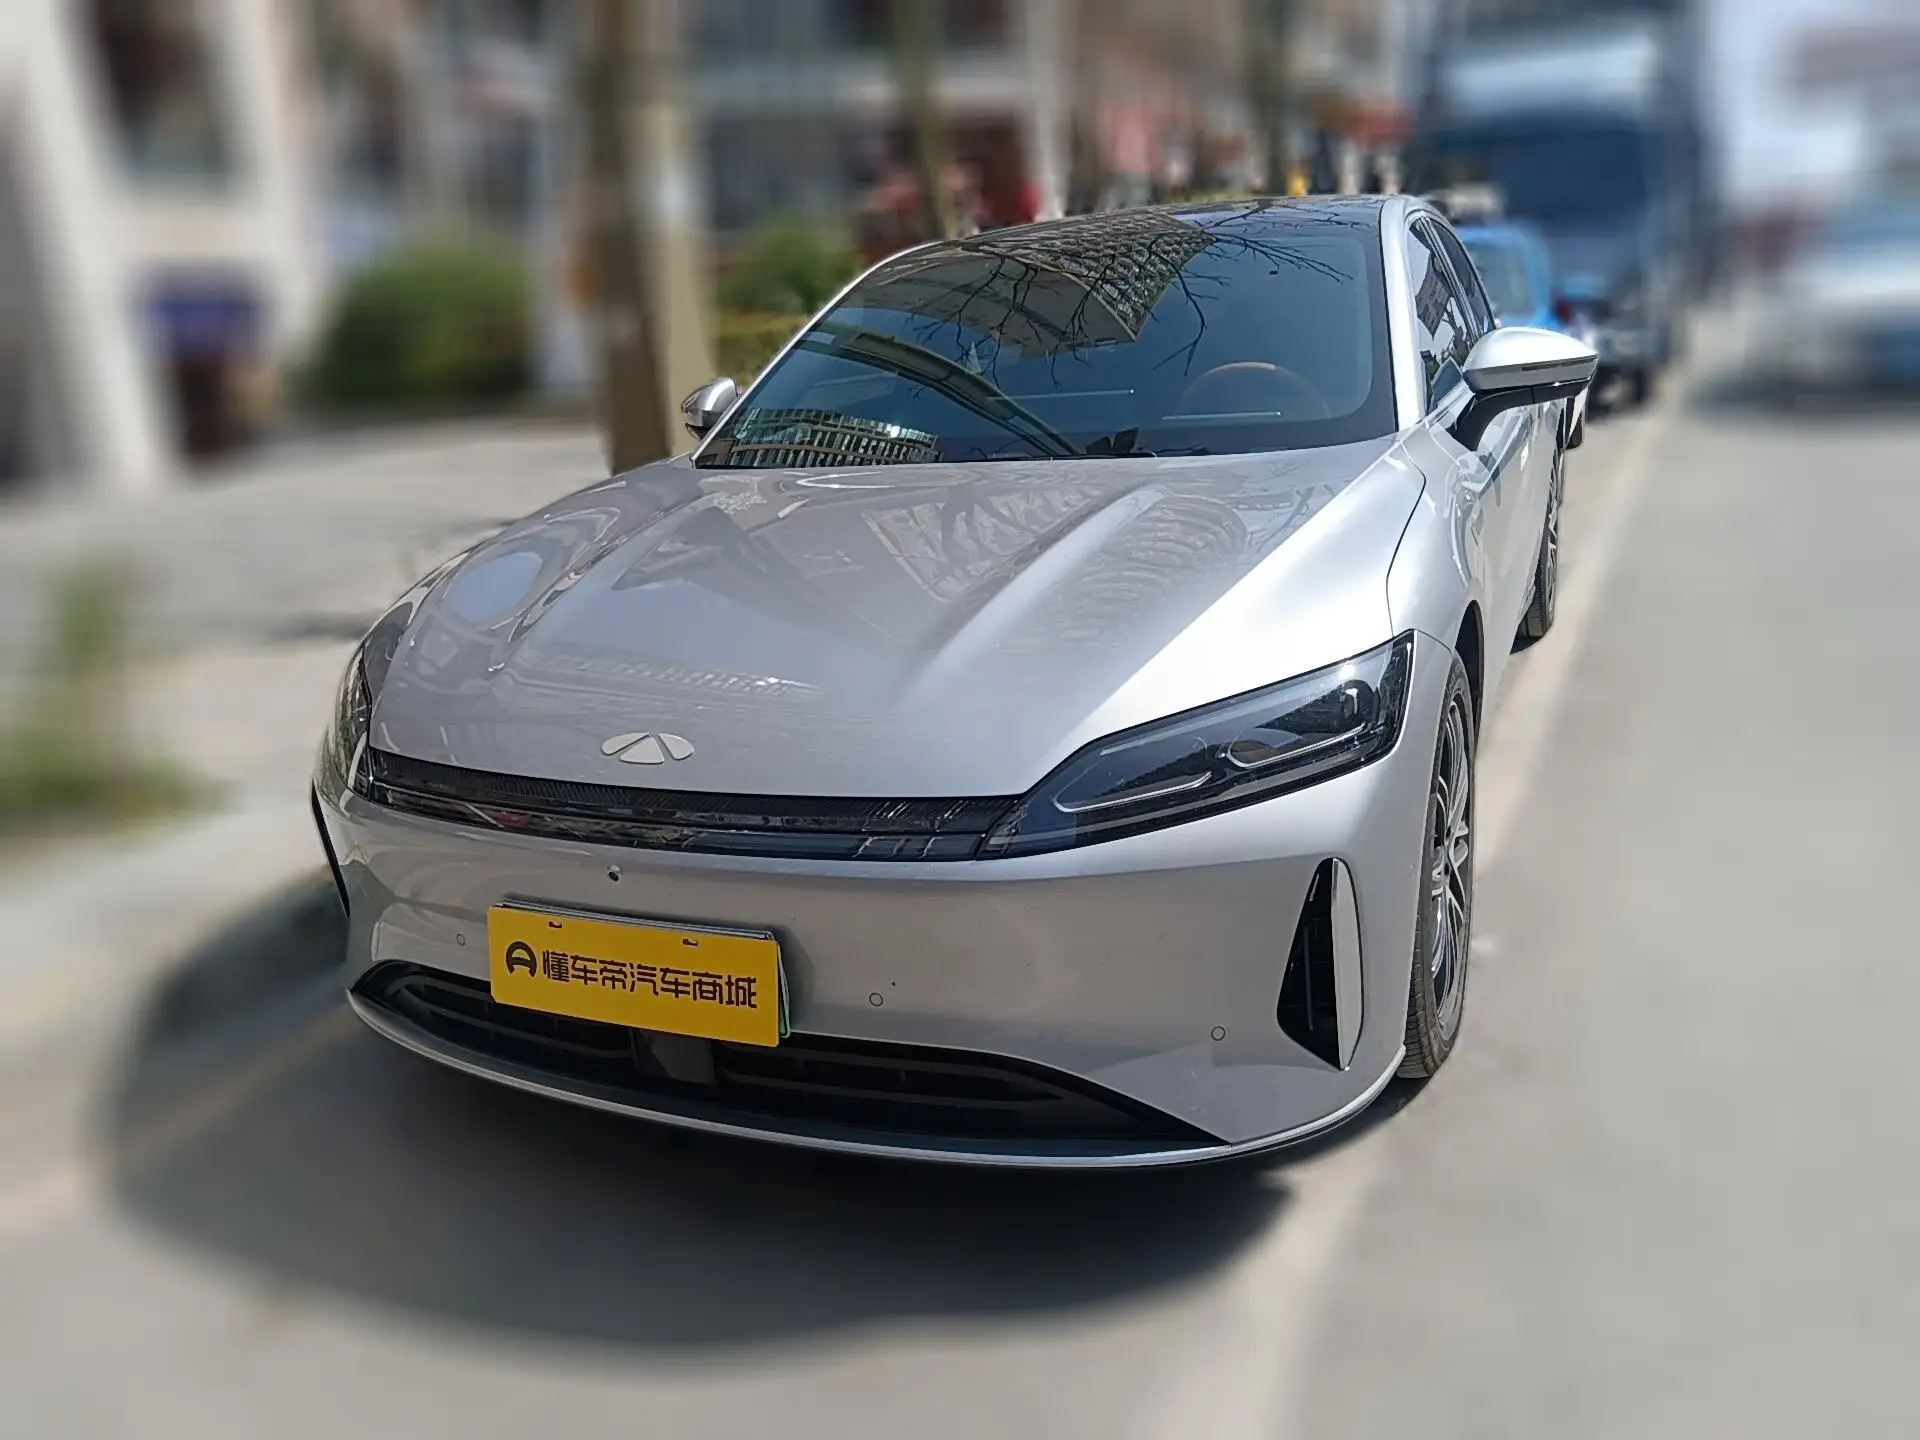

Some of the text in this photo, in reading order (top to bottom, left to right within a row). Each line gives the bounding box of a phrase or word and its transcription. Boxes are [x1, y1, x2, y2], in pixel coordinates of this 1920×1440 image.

[542, 950, 757, 1008] 懂车帝汽车商城
